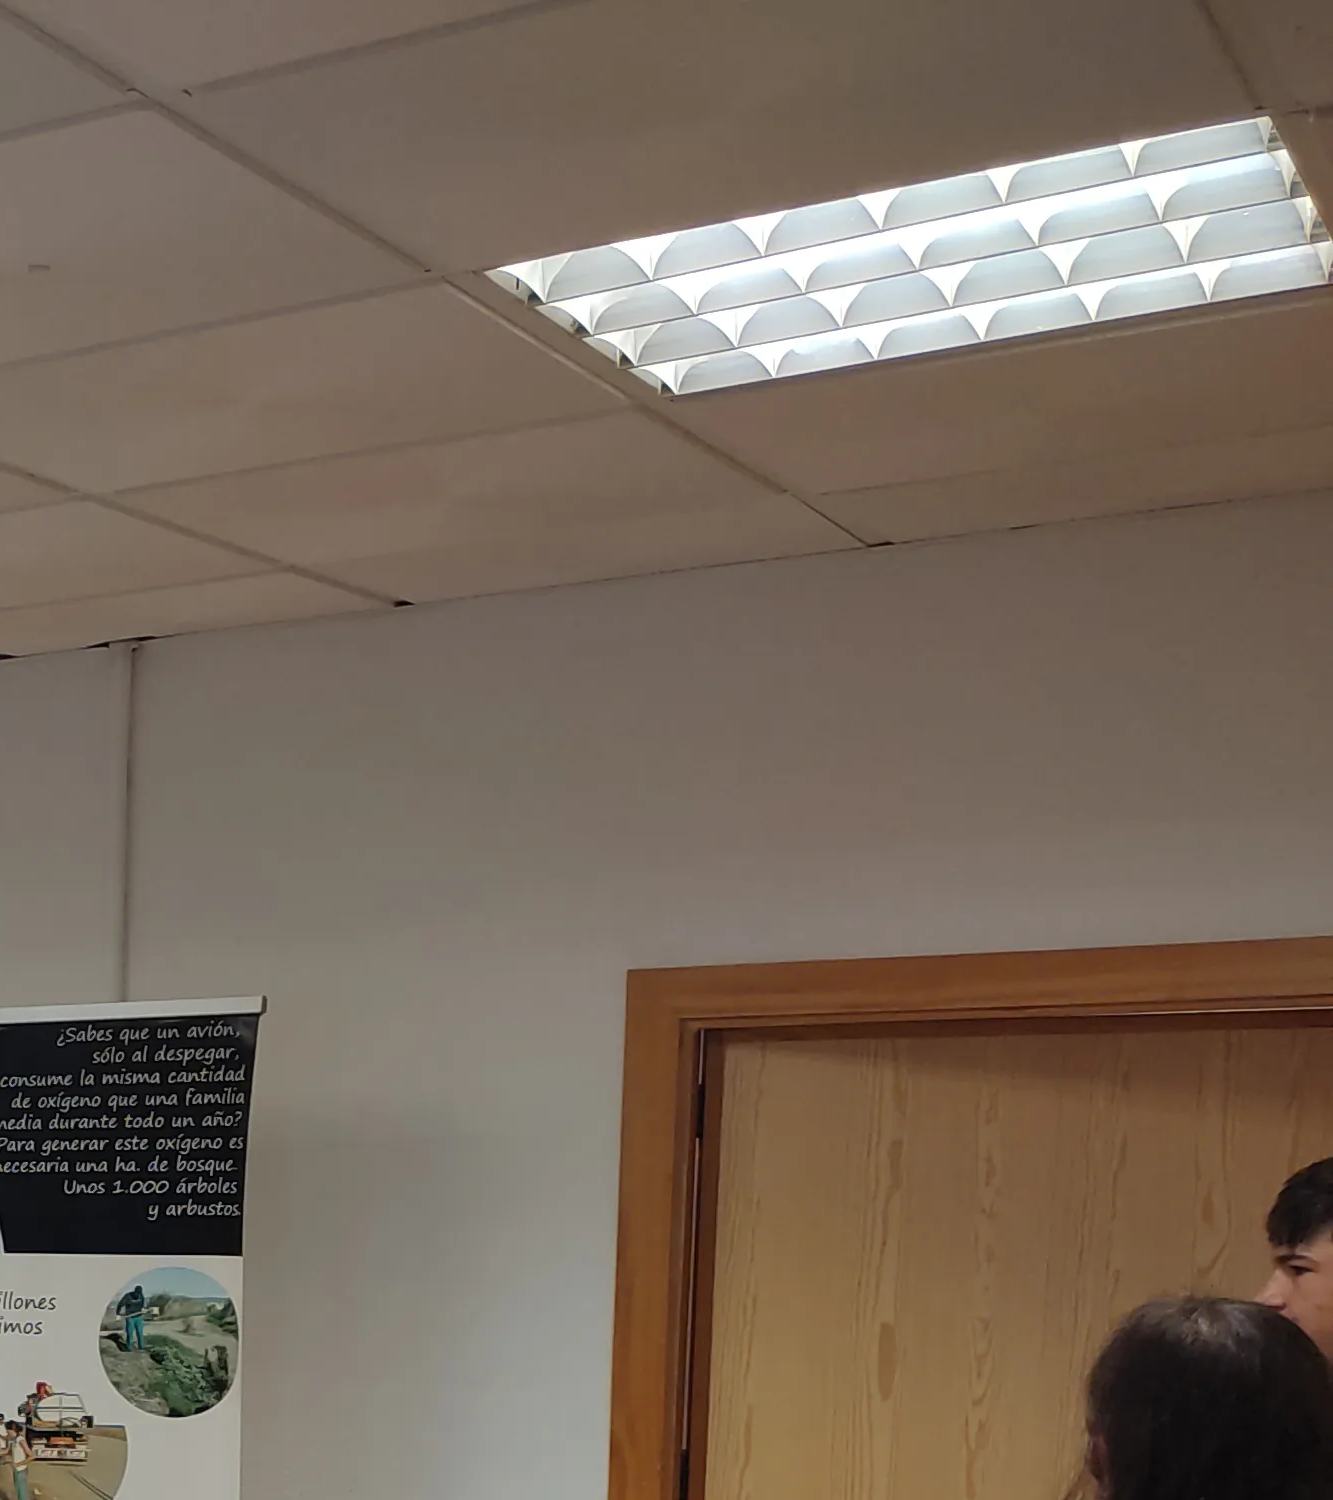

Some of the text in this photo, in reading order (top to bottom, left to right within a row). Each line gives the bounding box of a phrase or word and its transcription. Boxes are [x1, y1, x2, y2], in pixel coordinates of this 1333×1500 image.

[57, 1021, 241, 1047] ¿Sabes que un avión,
[92, 1045, 147, 1063] sólo al
[0, 1065, 245, 1087] consume la misma cantidad
[11, 1088, 244, 1112] de oxígeno que una familia
[49, 1116, 117, 1129] durante
[124, 1112, 164, 1128] todo
[172, 1116, 195, 1127] un
[202, 1111, 242, 1127] año?
[42, 1138, 108, 1155] generar
[115, 1138, 149, 1150] este
[156, 1134, 223, 1155] oxígeno
[229, 1136, 244, 1149] es
[76, 1161, 108, 1172] una
[148, 1156, 169, 1171] de
[64, 1177, 237, 1194] Unos 1.000 árboles
[147, 1205, 159, 1220] y
